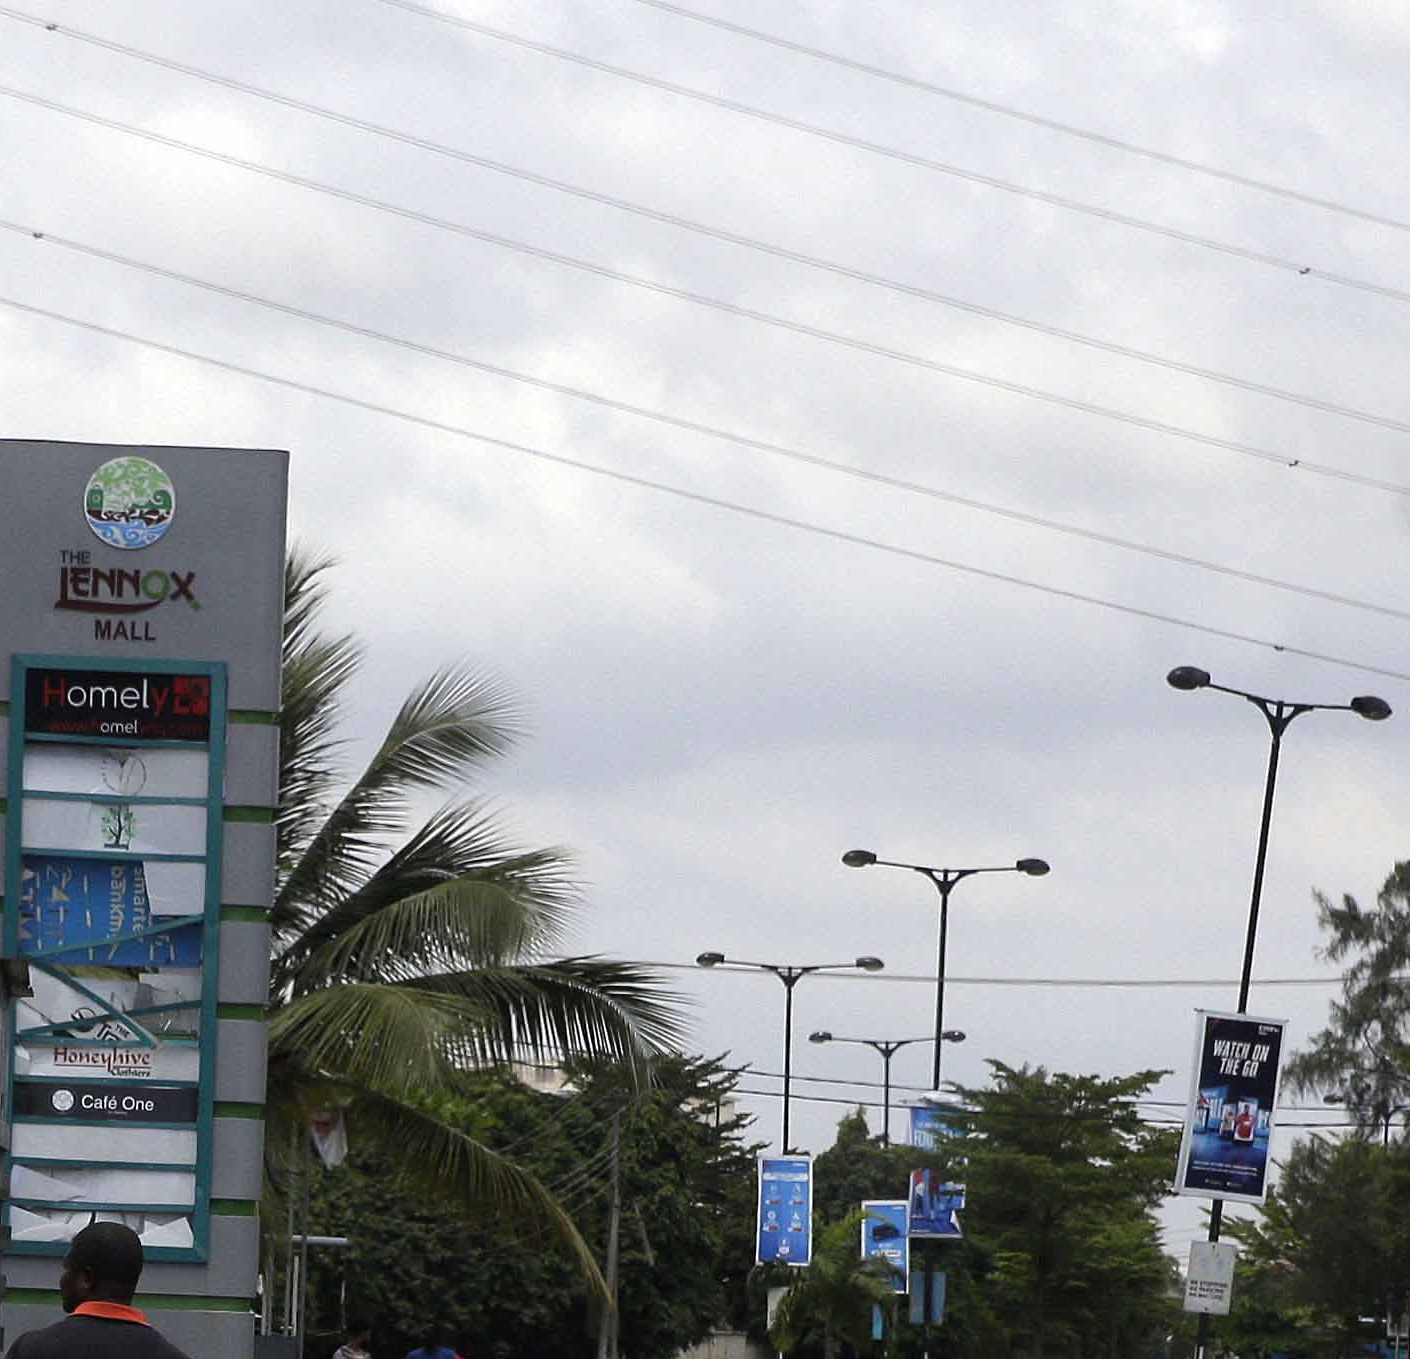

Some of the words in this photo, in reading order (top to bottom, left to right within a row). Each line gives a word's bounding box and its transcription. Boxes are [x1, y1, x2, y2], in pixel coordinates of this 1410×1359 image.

[60, 550, 90, 565] THE
[59, 567, 202, 611] LENNOX
[94, 619, 156, 641] MALL
[1213, 1039, 1251, 1060] WATCH
[1252, 1043, 1270, 1063] ON
[1219, 1057, 1241, 1076] THE
[1242, 1060, 1259, 1078] GO
[81, 1093, 118, 1110] Café
[122, 1095, 154, 1111] One
